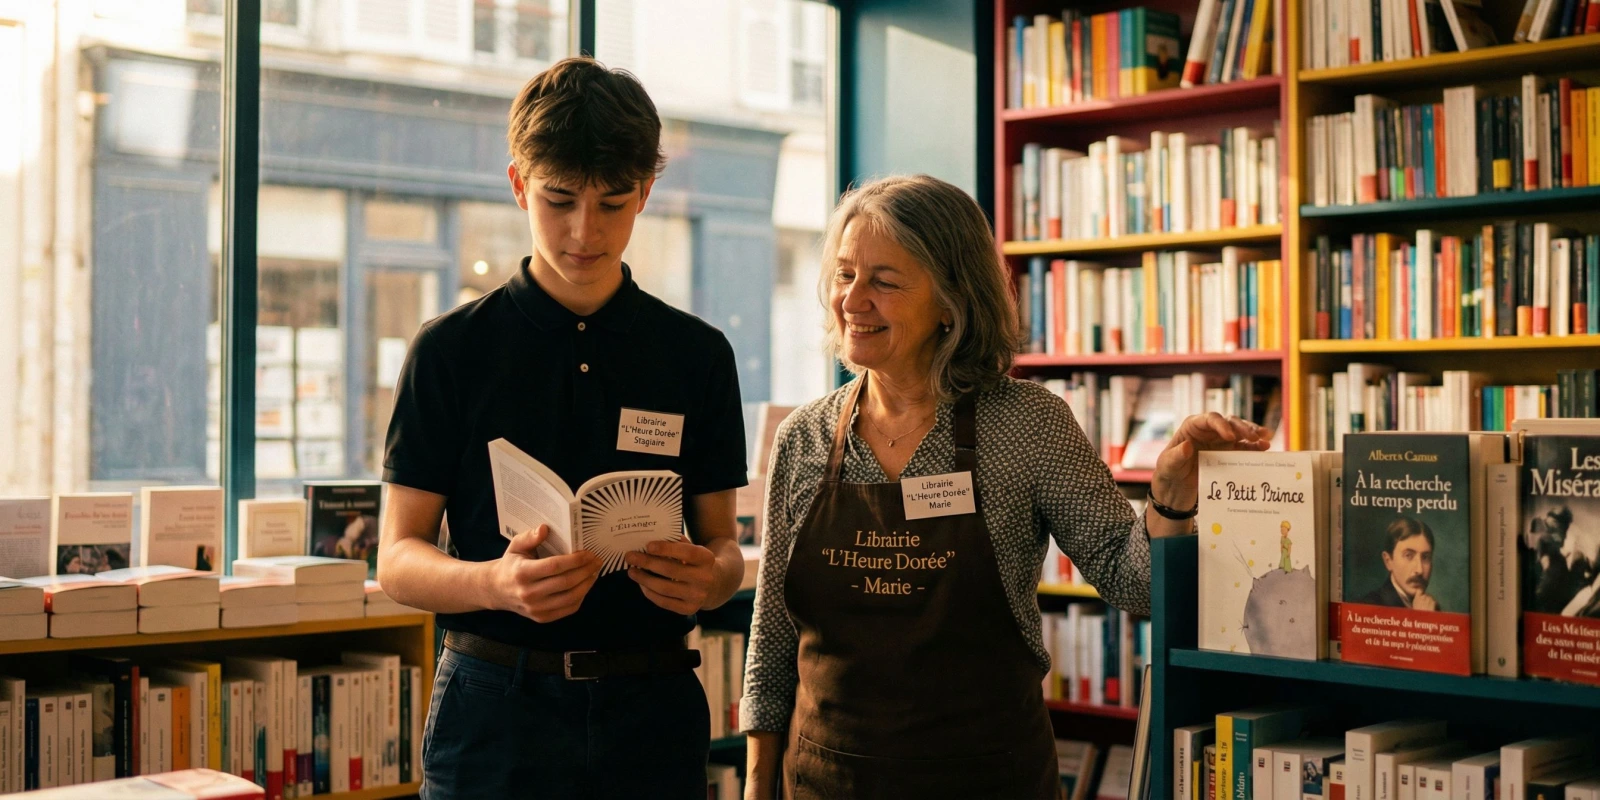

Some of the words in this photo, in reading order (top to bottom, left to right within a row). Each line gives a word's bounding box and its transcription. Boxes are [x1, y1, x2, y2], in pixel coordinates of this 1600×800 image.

[636, 416, 667, 427] Librairie
[634, 436, 665, 447] Stagiaire
[1404, 450, 1438, 462] Camus
[1571, 447, 1600, 470] Les
[921, 480, 954, 490] Librairie
[1355, 469, 1367, 488] À
[1370, 473, 1382, 489] la
[1386, 474, 1452, 491] recherche
[1207, 481, 1222, 500] Le
[1226, 481, 1257, 501] Petit
[1261, 482, 1305, 503] Prince
[929, 500, 952, 509] Marie
[1350, 490, 1368, 506] du
[1371, 496, 1413, 513] temps
[1416, 494, 1457, 513] perdu
[854, 530, 920, 547] Librairie
[864, 576, 911, 594] Marie
